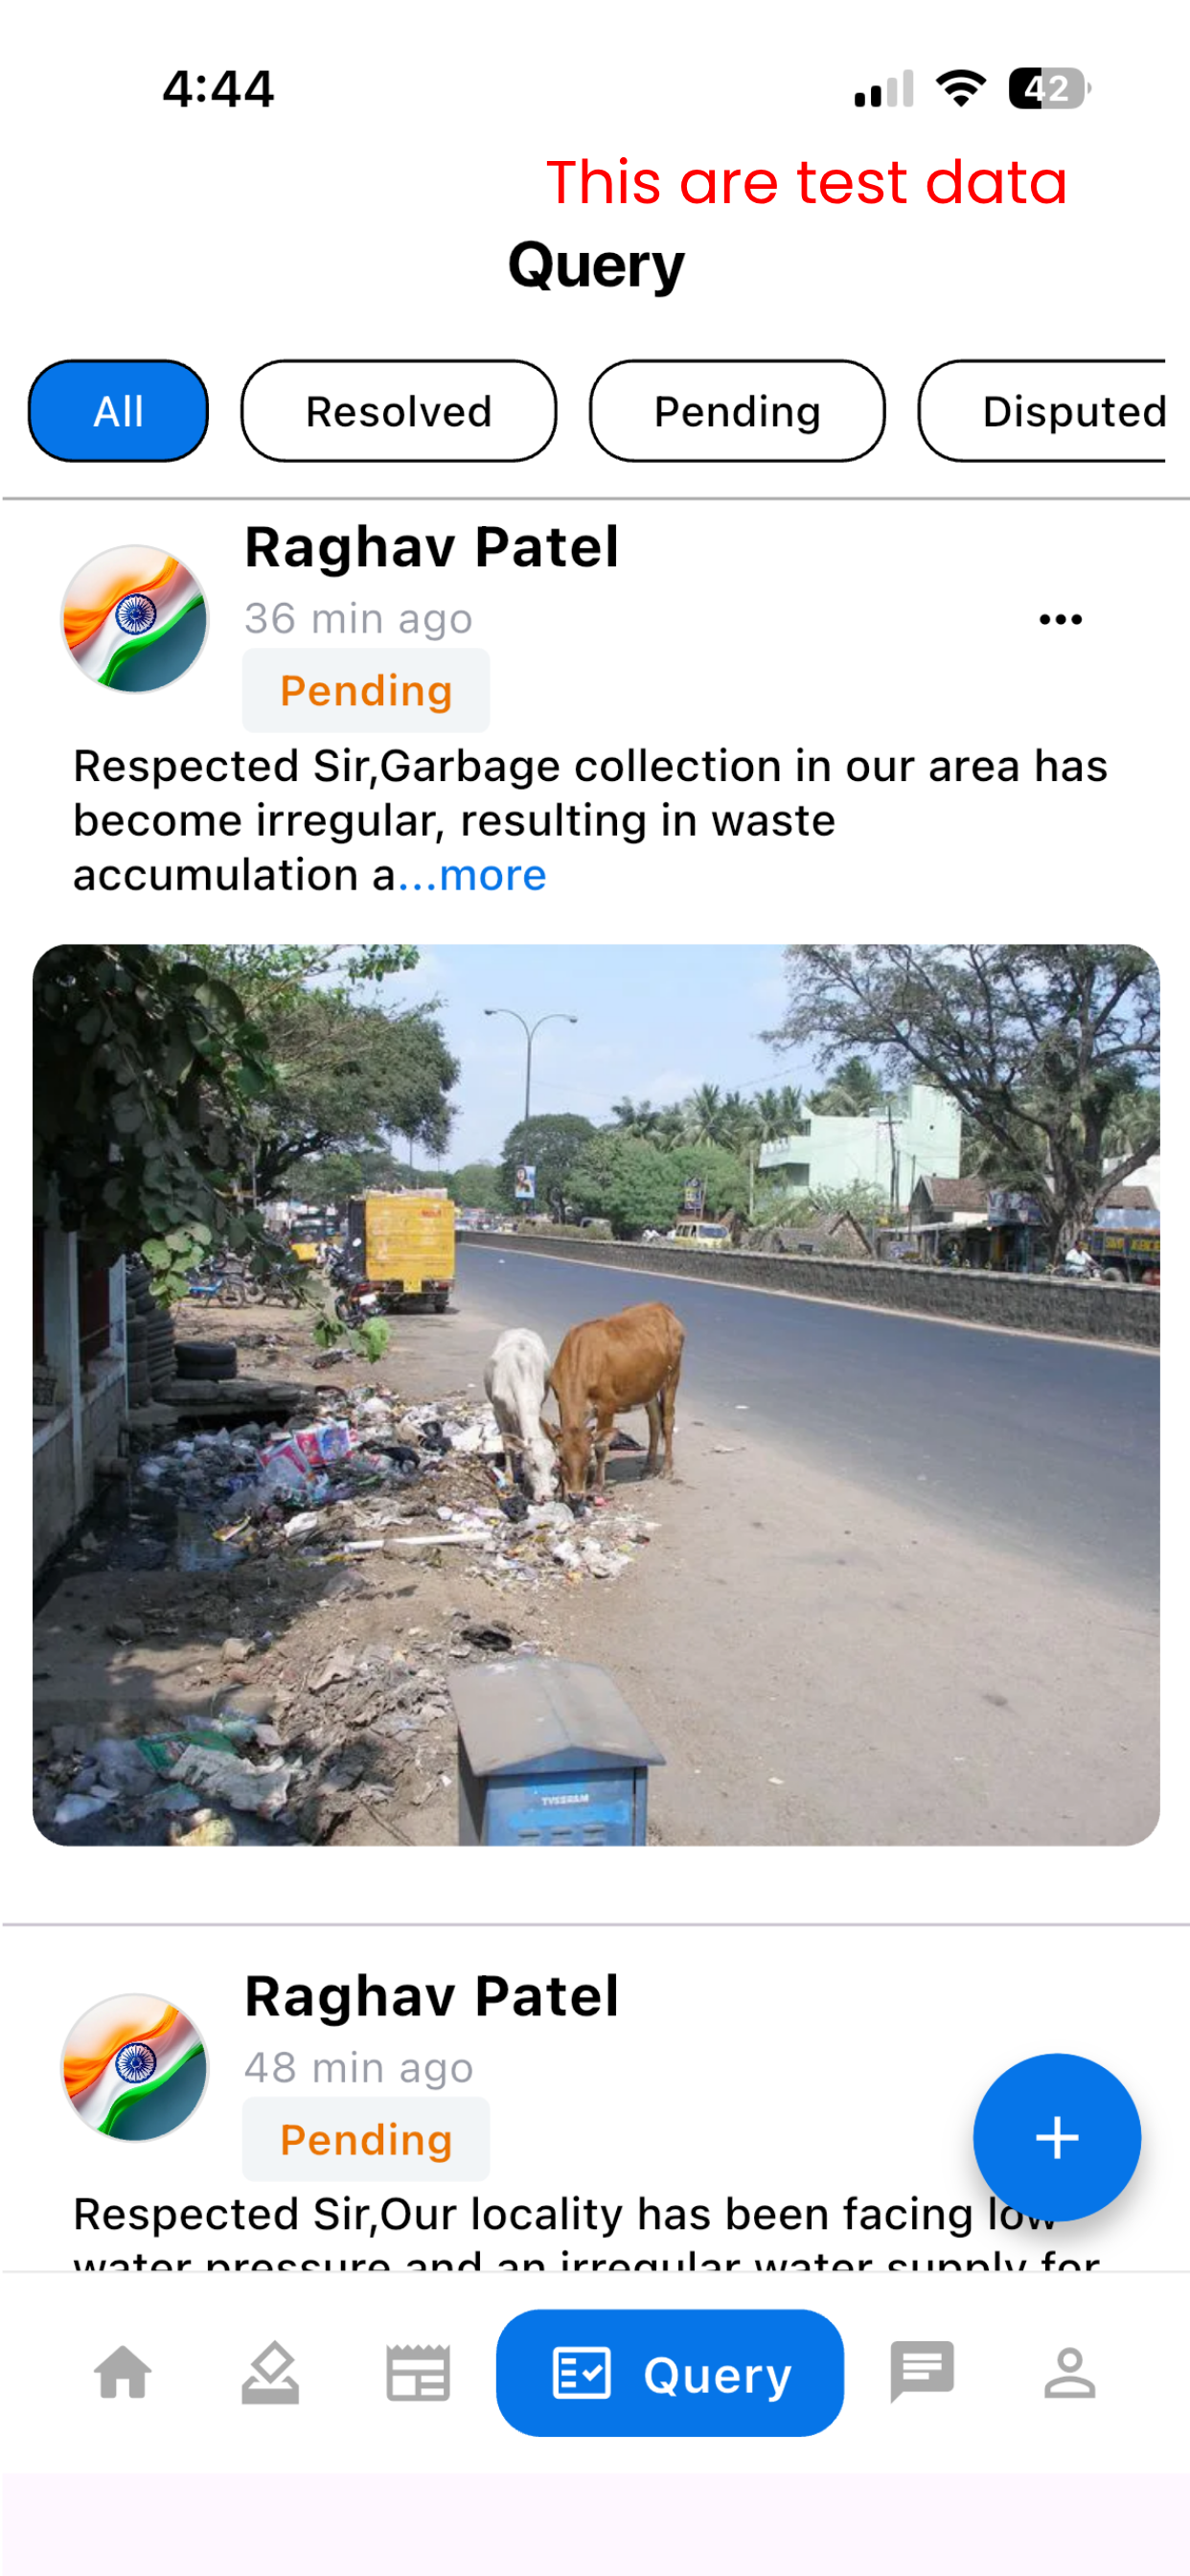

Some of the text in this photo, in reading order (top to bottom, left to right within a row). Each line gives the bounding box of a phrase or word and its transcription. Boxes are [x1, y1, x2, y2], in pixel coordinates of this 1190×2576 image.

[163, 70, 274, 107] 4:44
[1024, 75, 1068, 102] 42
[509, 241, 686, 297] Query
[93, 395, 142, 426] All
[309, 395, 491, 427] Resolved
[656, 394, 819, 434] Pending
[985, 394, 1165, 434] Disputed
[247, 524, 616, 578] Raghav Patel
[245, 602, 472, 641] 36 min ago
[283, 673, 450, 714] Pending
[76, 748, 1107, 790] Respected Sir,Garbage collection in our area has
[76, 802, 835, 844] become irregular, resulting in waste
[74, 857, 356, 890] accumulation
[247, 1973, 616, 2027] Raghav Patel
[245, 2051, 472, 2090] 48 min ago
[283, 2122, 450, 2163] Pending
[76, 2196, 297, 2238] Respected
[314, 2196, 457, 2238] Sir,Our
[473, 2196, 623, 2238] locality
[639, 2196, 710, 2230] has
[727, 2196, 827, 2230] been
[843, 2196, 972, 2238] facing
[645, 2357, 791, 2403] Query
